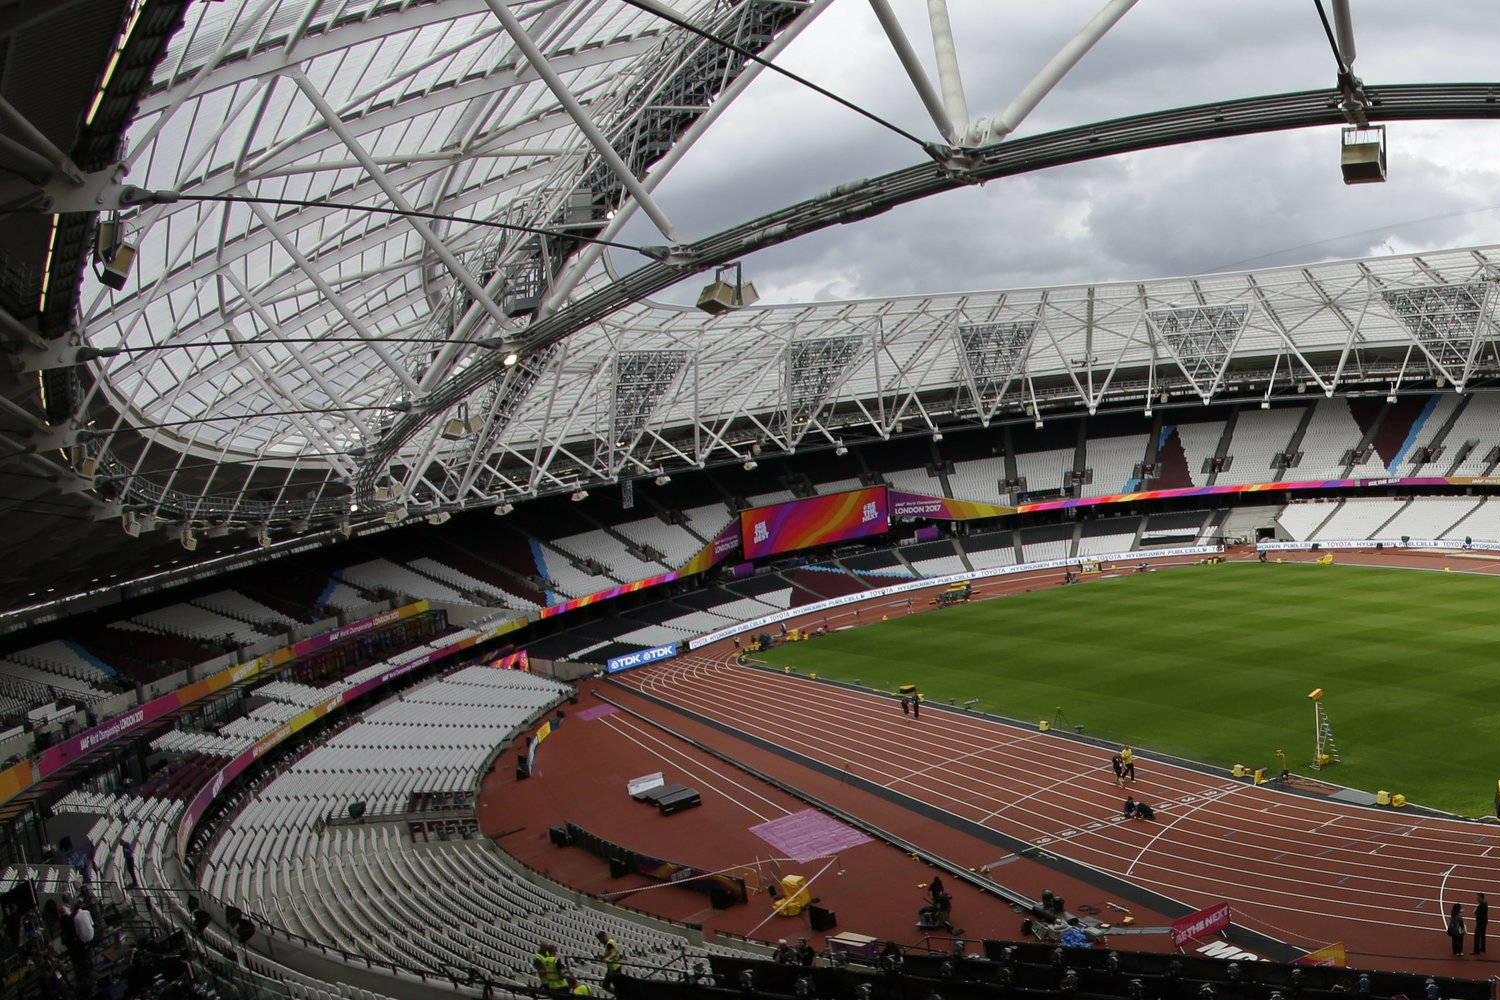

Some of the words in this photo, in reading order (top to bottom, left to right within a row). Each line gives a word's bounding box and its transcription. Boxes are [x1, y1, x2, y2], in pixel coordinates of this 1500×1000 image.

[895, 505, 924, 515] LONDON
[925, 504, 942, 513] 2017
[1357, 541, 1396, 549] HYDRGEN
[618, 654, 641, 667] TDK
[648, 646, 674, 659] TDK
[1187, 917, 1206, 938] THE
[1205, 906, 1229, 928] NEXT
